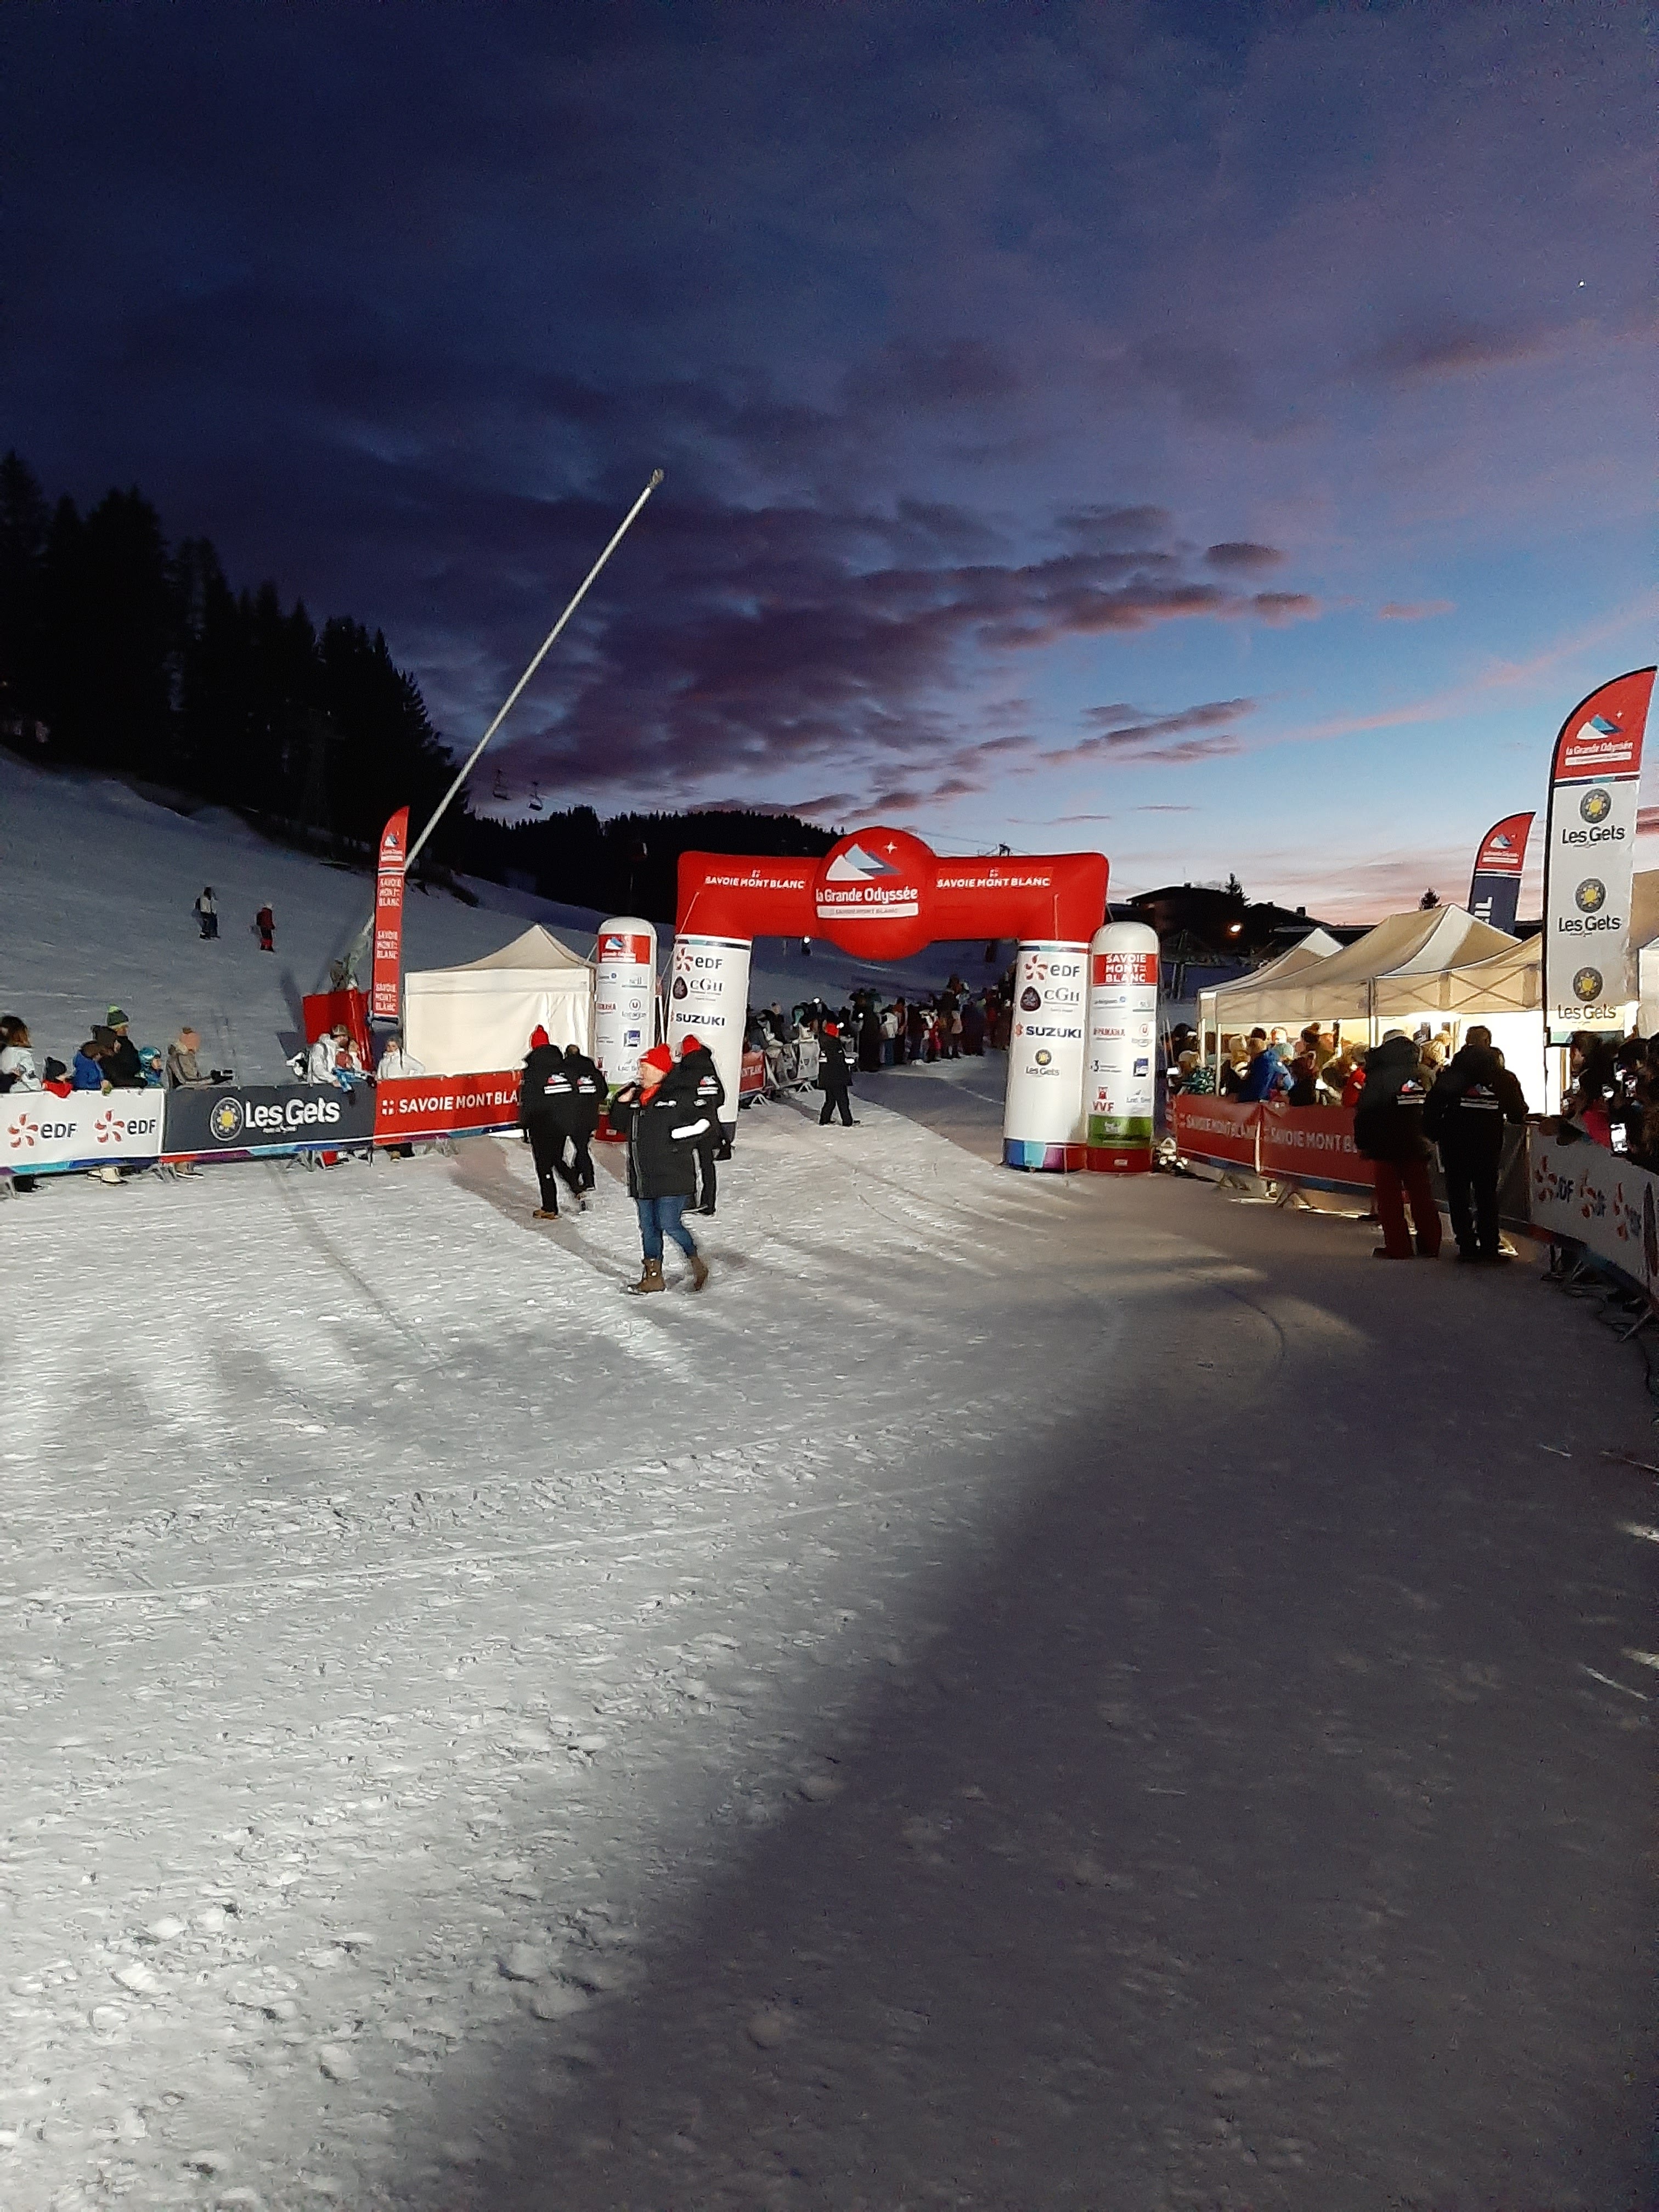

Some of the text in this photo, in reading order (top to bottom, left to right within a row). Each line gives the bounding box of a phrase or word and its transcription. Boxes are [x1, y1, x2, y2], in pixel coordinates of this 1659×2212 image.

[1562, 825, 1626, 844] Les Gets
[704, 876, 805, 889] SAVOIE MONT BLANC
[936, 877, 1051, 888] SAVOIE MONT BLANC
[825, 887, 862, 902] Grande
[864, 885, 918, 905] Odyssée
[1559, 915, 1621, 932] Les Gets
[1105, 954, 1147, 963] SAVOIE
[1105, 973, 1146, 983] BLANC
[1558, 1003, 1616, 1019] Les Gets
[675, 1013, 725, 1026] SUZUKI
[1025, 1025, 1082, 1039] SUZUKI
[399, 1090, 521, 1114] SAVOIE MONT BLA
[246, 1096, 341, 1128] Les Gets
[1306, 1131, 1341, 1152] MONT
